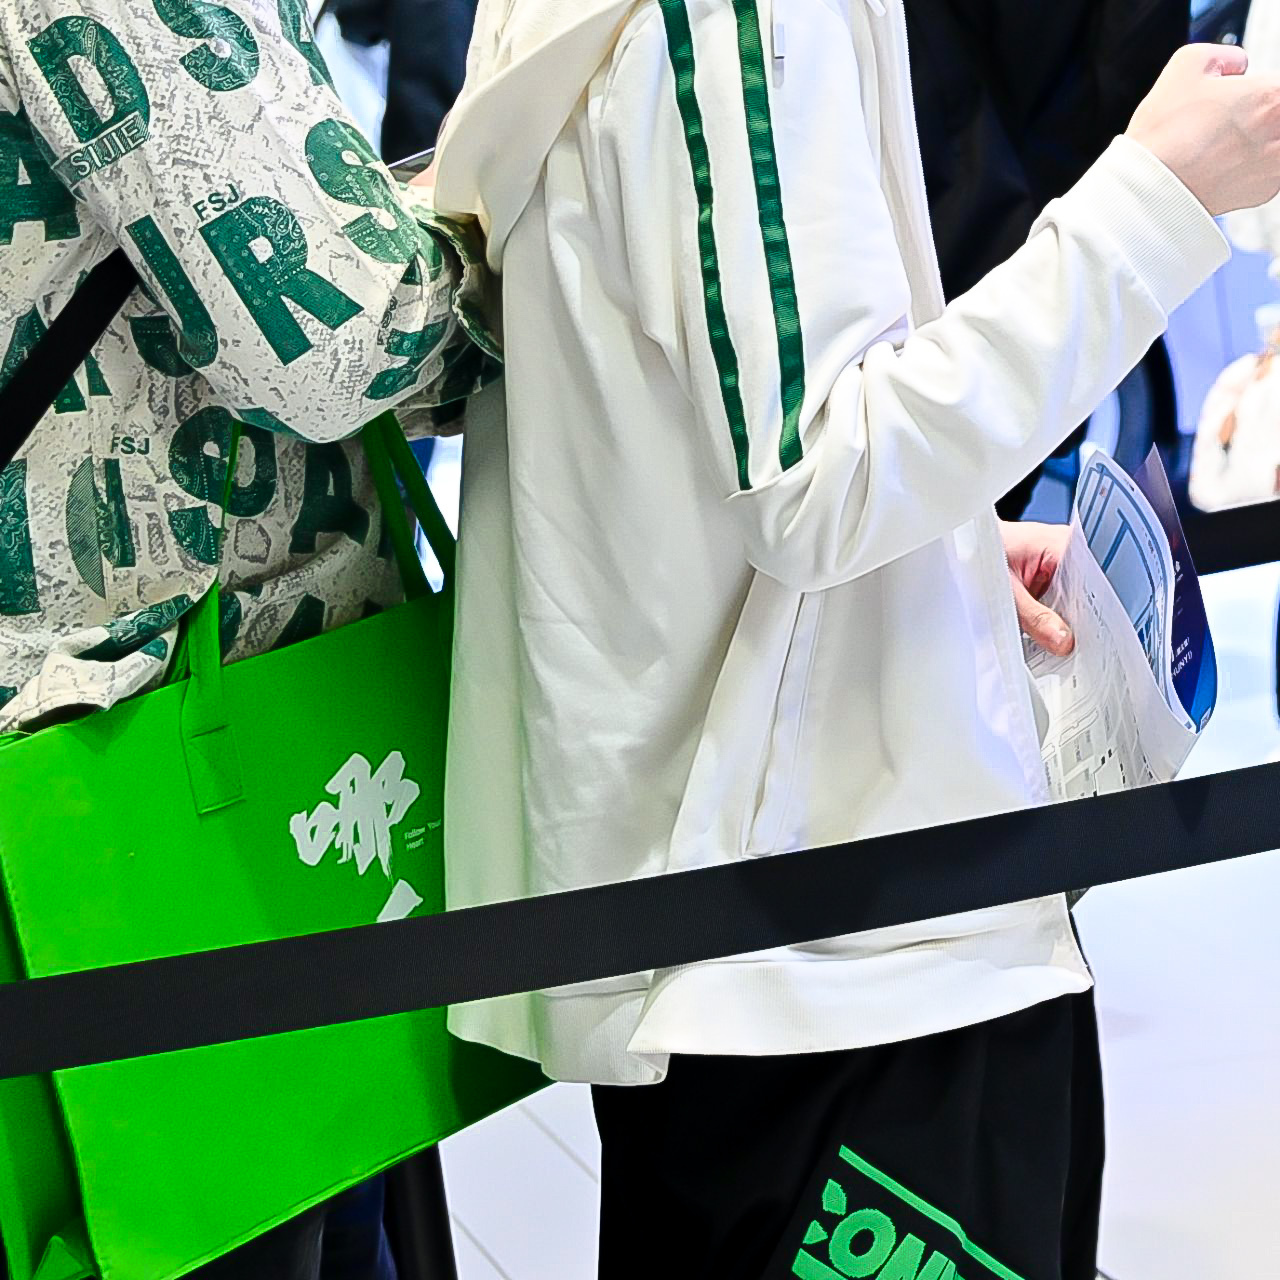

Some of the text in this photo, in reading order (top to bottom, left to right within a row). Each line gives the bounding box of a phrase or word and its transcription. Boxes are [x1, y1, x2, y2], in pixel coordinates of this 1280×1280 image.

[70, 120, 145, 177] SIJIE
[192, 183, 240, 220] FSJ
[111, 435, 150, 455] FSJ
